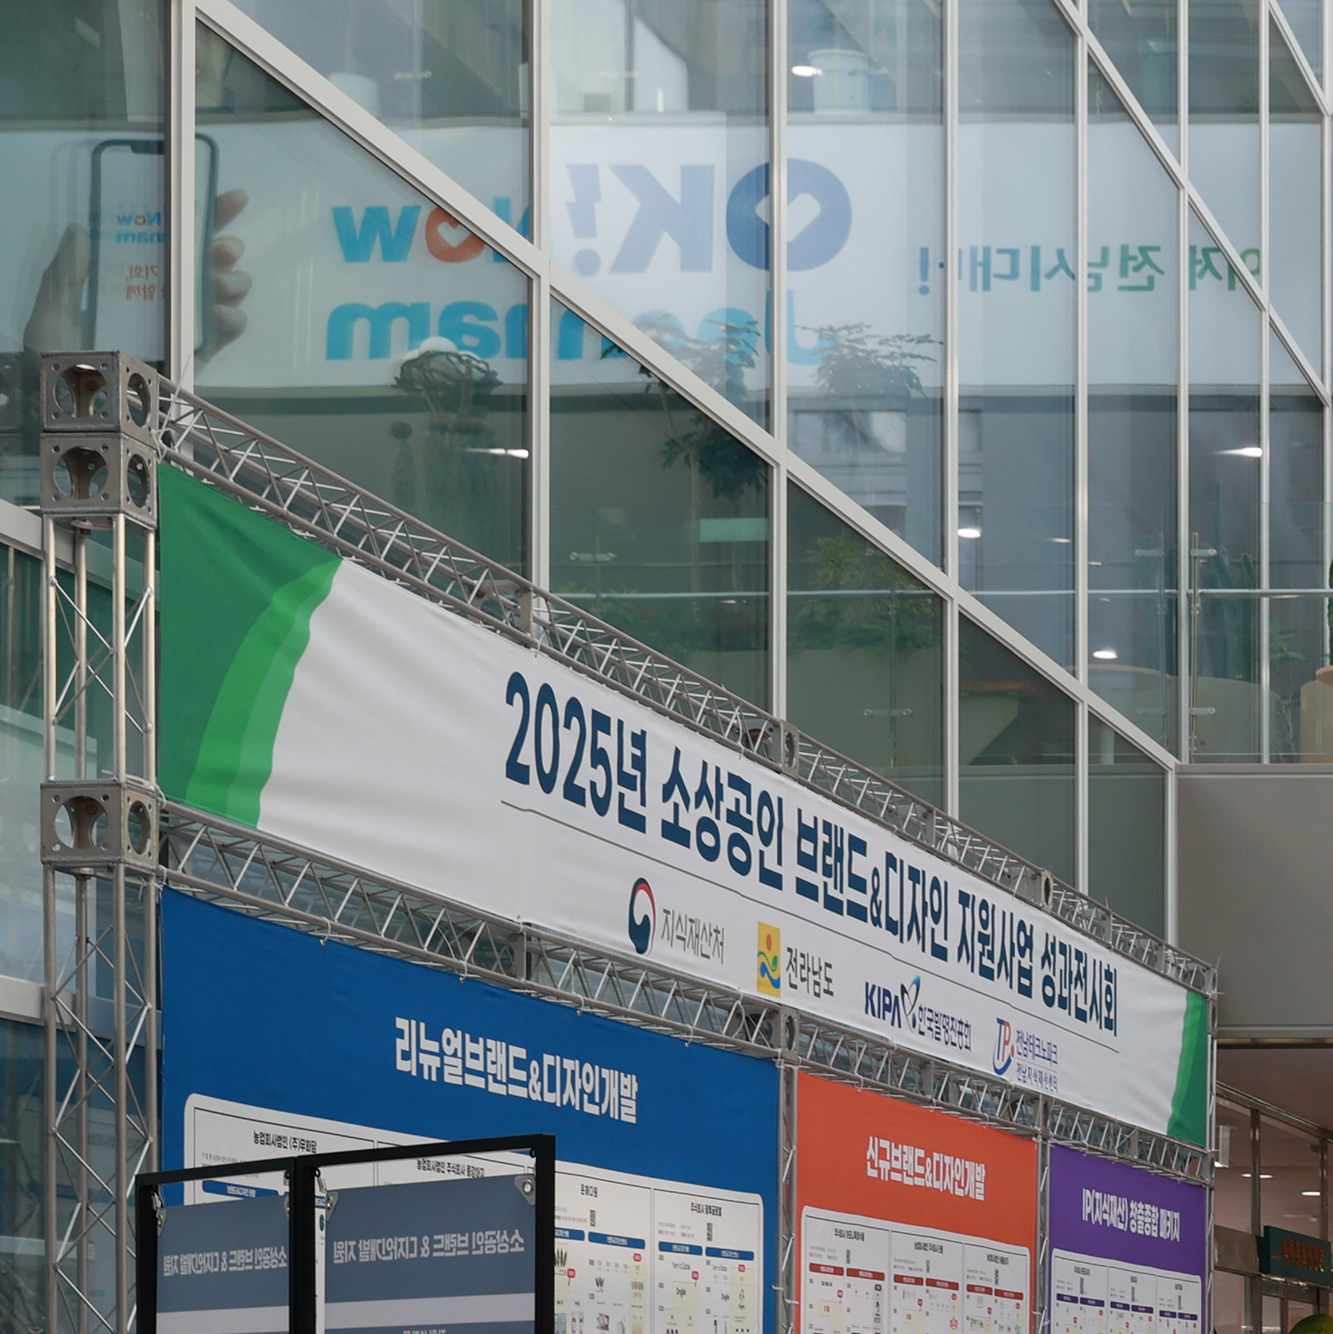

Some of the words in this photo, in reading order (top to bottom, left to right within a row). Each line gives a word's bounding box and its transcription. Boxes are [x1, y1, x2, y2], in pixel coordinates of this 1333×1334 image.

[505, 671, 647, 834] 2025년
[661, 745, 783, 891] 소상공인
[795, 807, 948, 963] 브랜드&디자인
[957, 888, 1034, 1000] 지원사업
[1040, 931, 1118, 1037] 성과전시회
[661, 907, 724, 964] 지식재산처
[786, 946, 834, 999] 전라남도
[918, 1003, 972, 1052] 한국발명진흥회
[1016, 1029, 1058, 1065] 전남테크노파크
[395, 1017, 638, 1124] 리뉴얼브랜드&디자인개발
[1016, 1062, 1059, 1094] 전남지식재산센터
[866, 1136, 986, 1201] 신규브랜드&디자인개발
[1082, 1188, 1128, 1231] IP(지식재산)
[1130, 1200, 1158, 1237] 창출종합
[1160, 1208, 1180, 1242] 패키지
